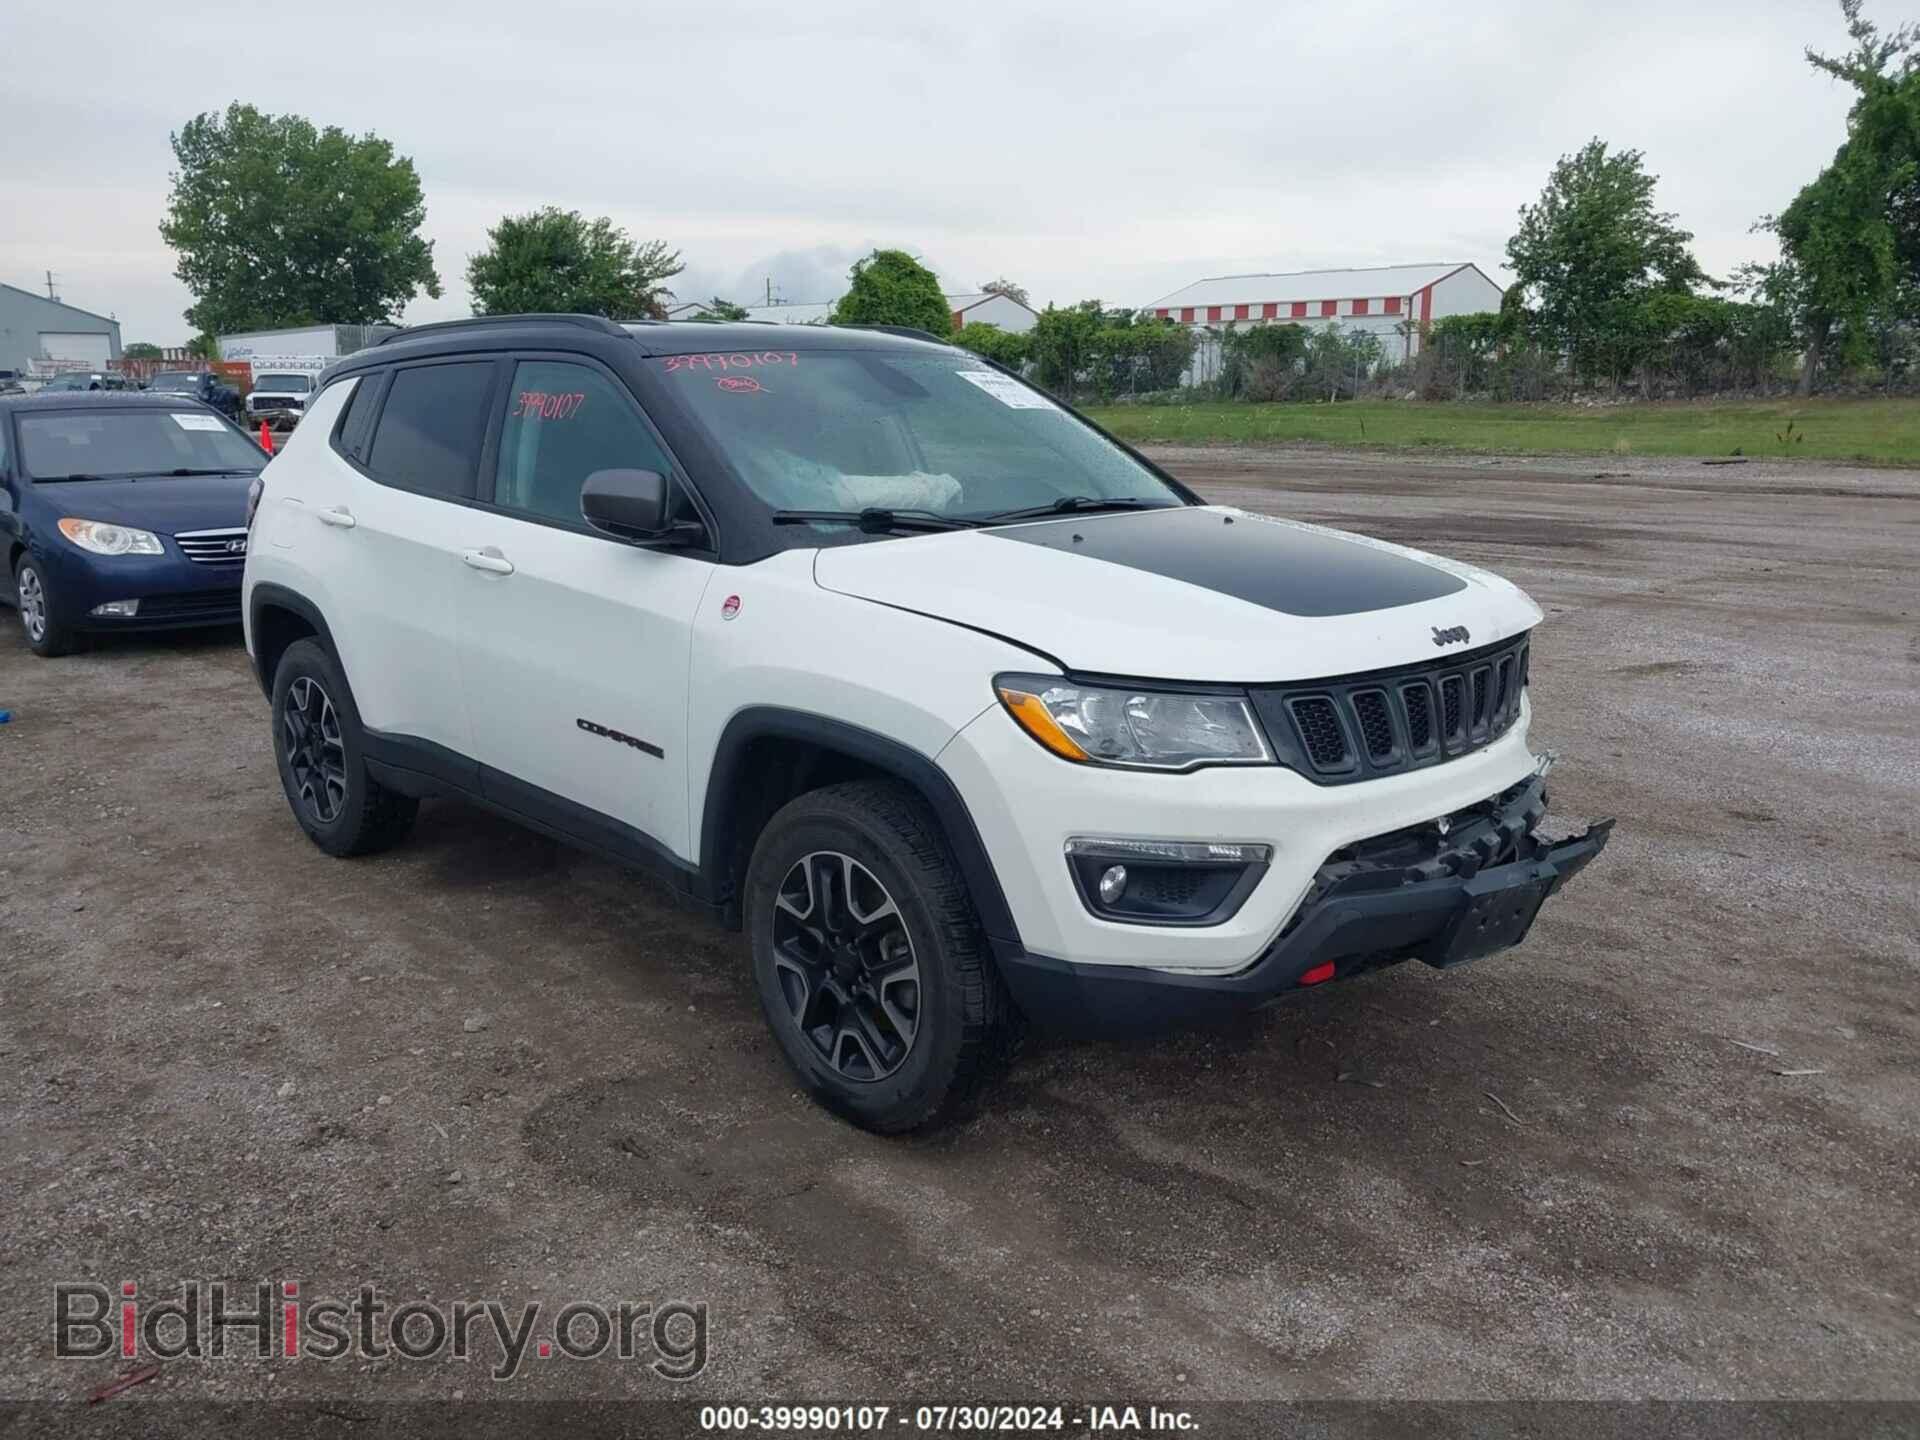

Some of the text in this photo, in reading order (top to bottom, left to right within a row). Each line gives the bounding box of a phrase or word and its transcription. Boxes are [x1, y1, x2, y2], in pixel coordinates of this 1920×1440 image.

[664, 352, 798, 373] 39990107
[512, 392, 585, 419] 39990107
[1431, 625, 1470, 647] Jeep
